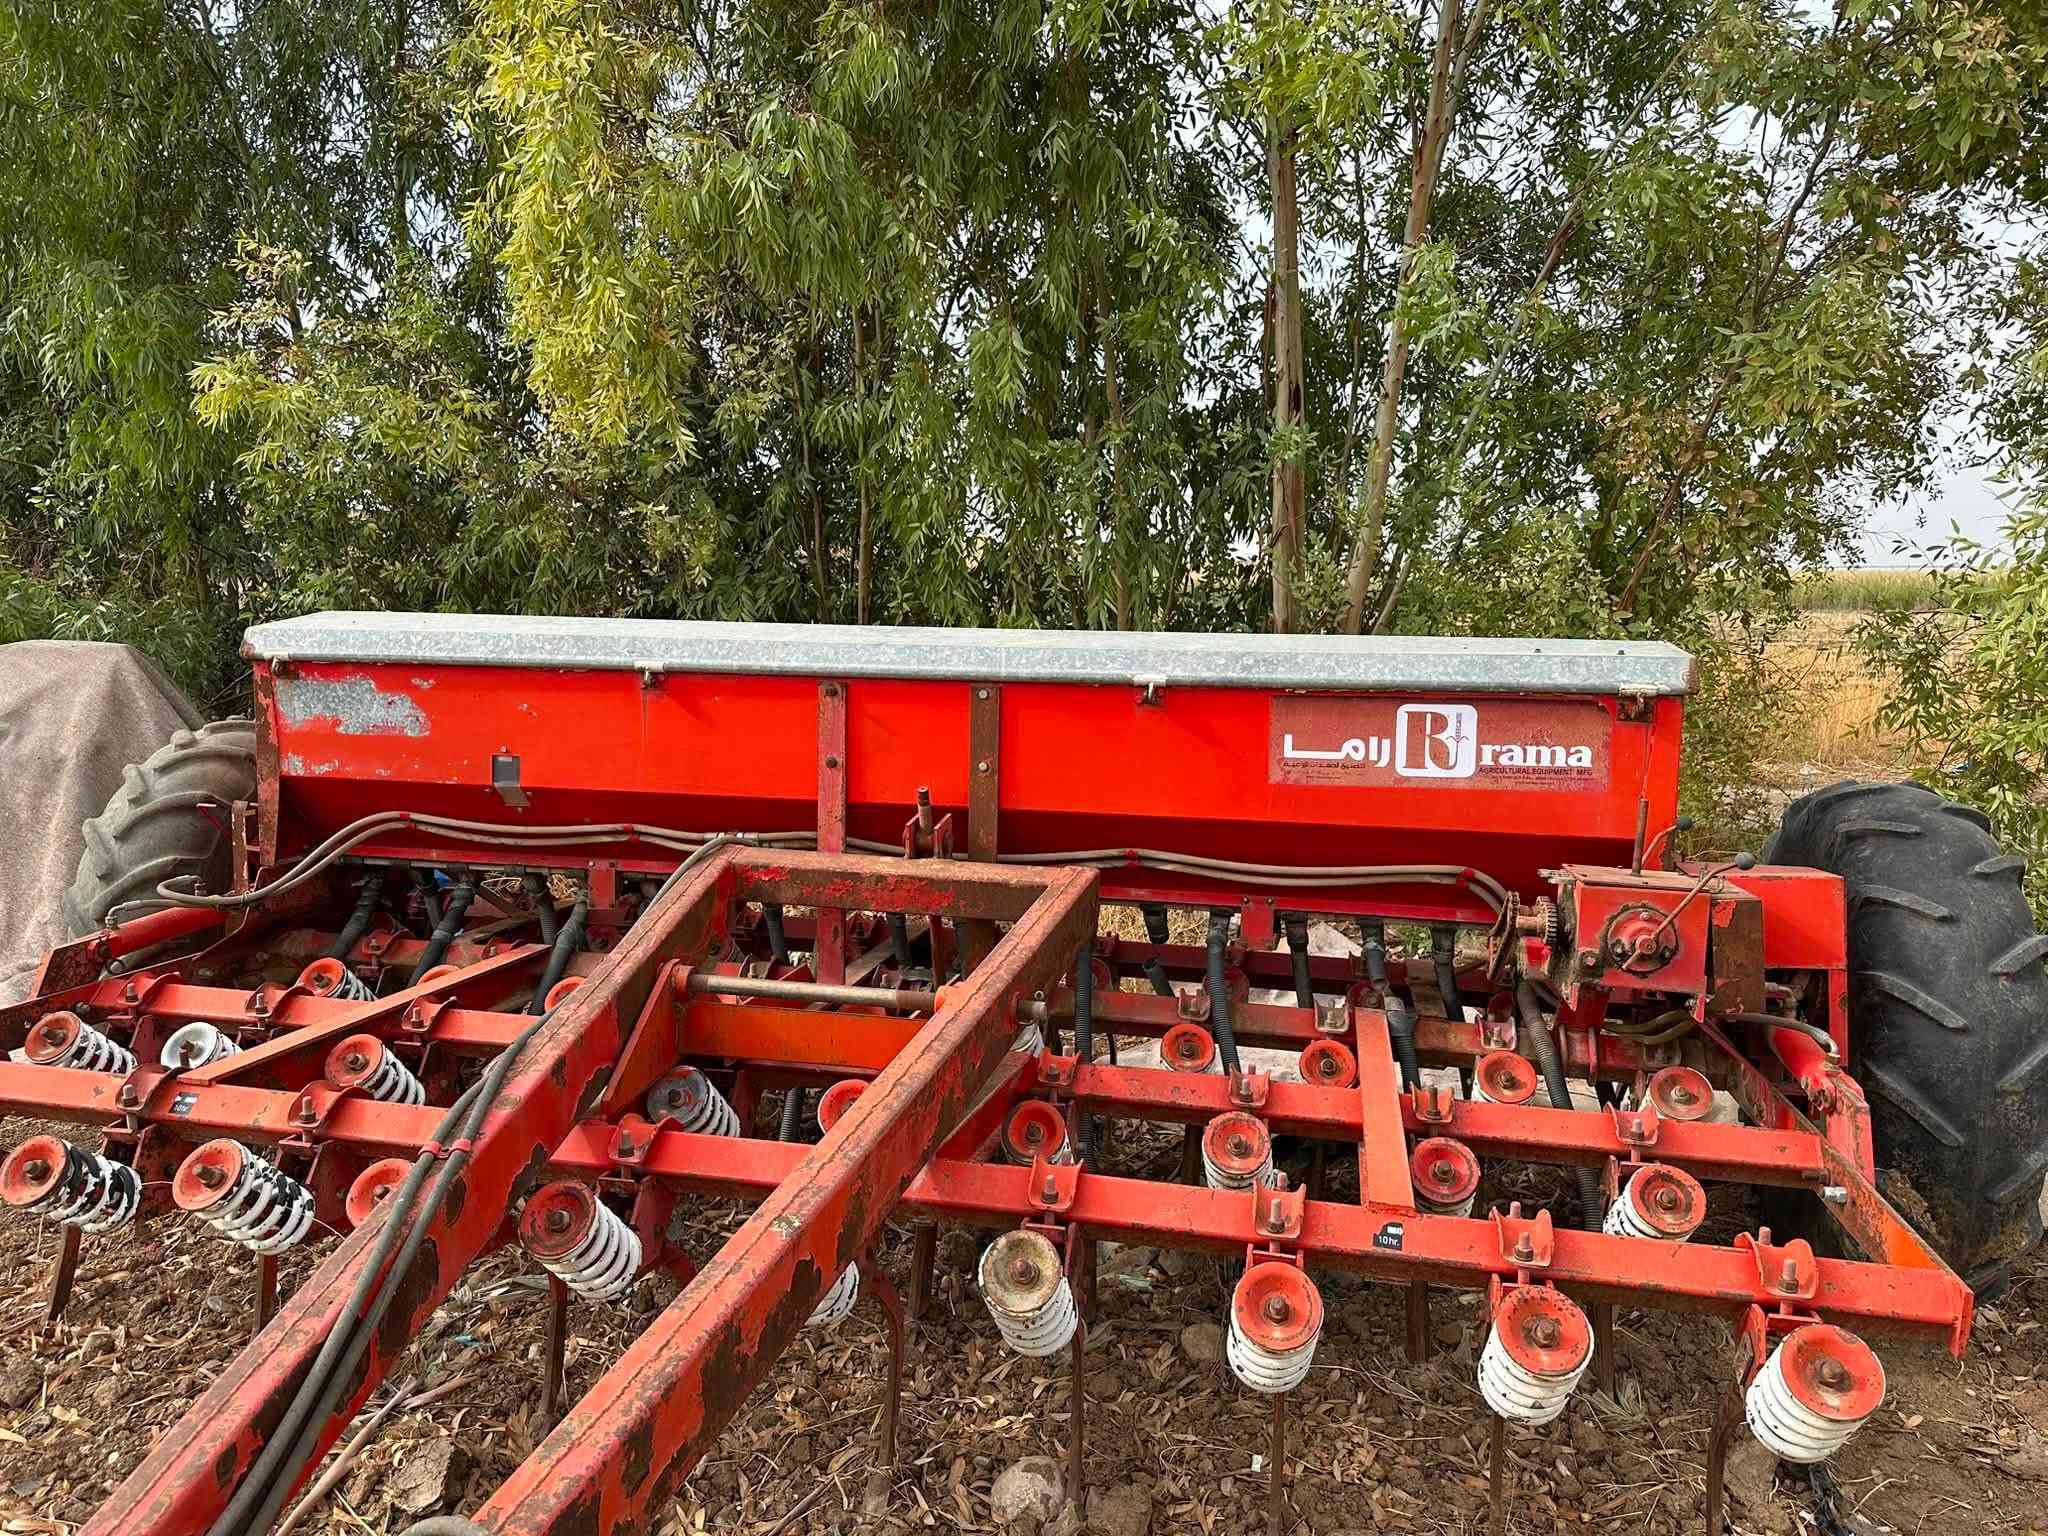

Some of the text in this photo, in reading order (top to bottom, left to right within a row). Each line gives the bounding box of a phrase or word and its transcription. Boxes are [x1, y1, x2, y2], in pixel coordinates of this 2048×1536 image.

[1283, 733, 1391, 768] راما
[1479, 744, 1593, 768] rama
[1478, 766, 1531, 775] AGRICULTURAL
[1532, 767, 1572, 776] EQUIPMENT
